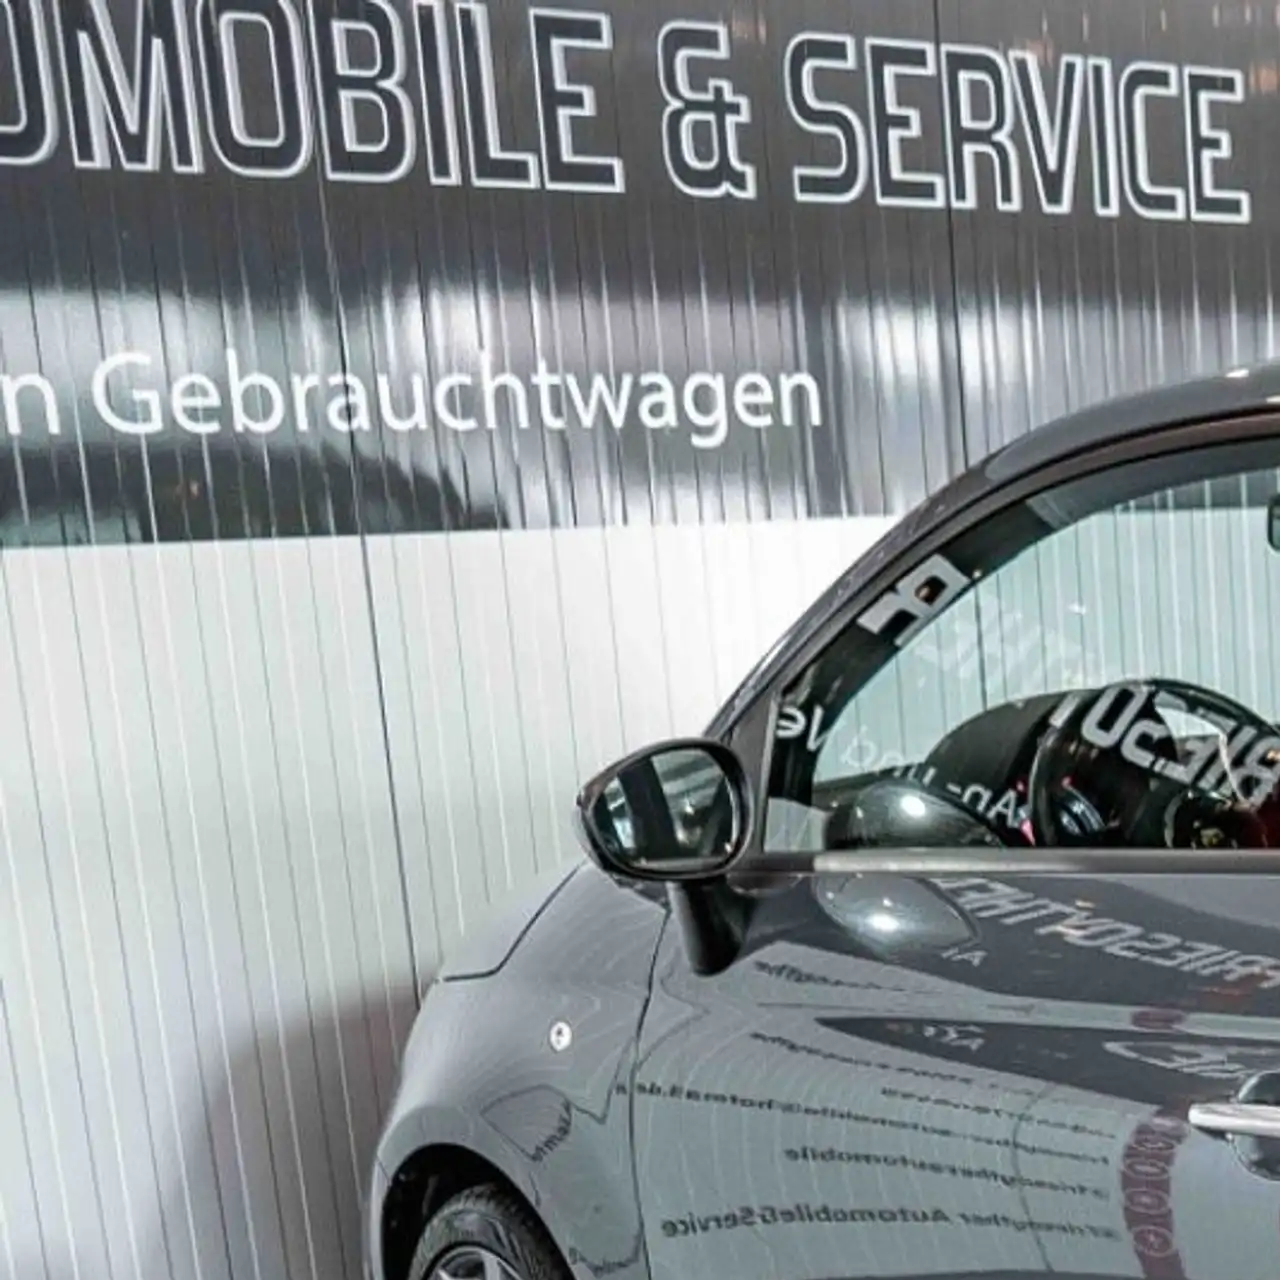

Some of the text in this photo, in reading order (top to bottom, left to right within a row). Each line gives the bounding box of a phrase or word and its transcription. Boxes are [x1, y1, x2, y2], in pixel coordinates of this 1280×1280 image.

[658, 20, 757, 199] &
[784, 32, 1251, 225] SERVICE
[91, 347, 824, 449] Gebrauchtwagen
